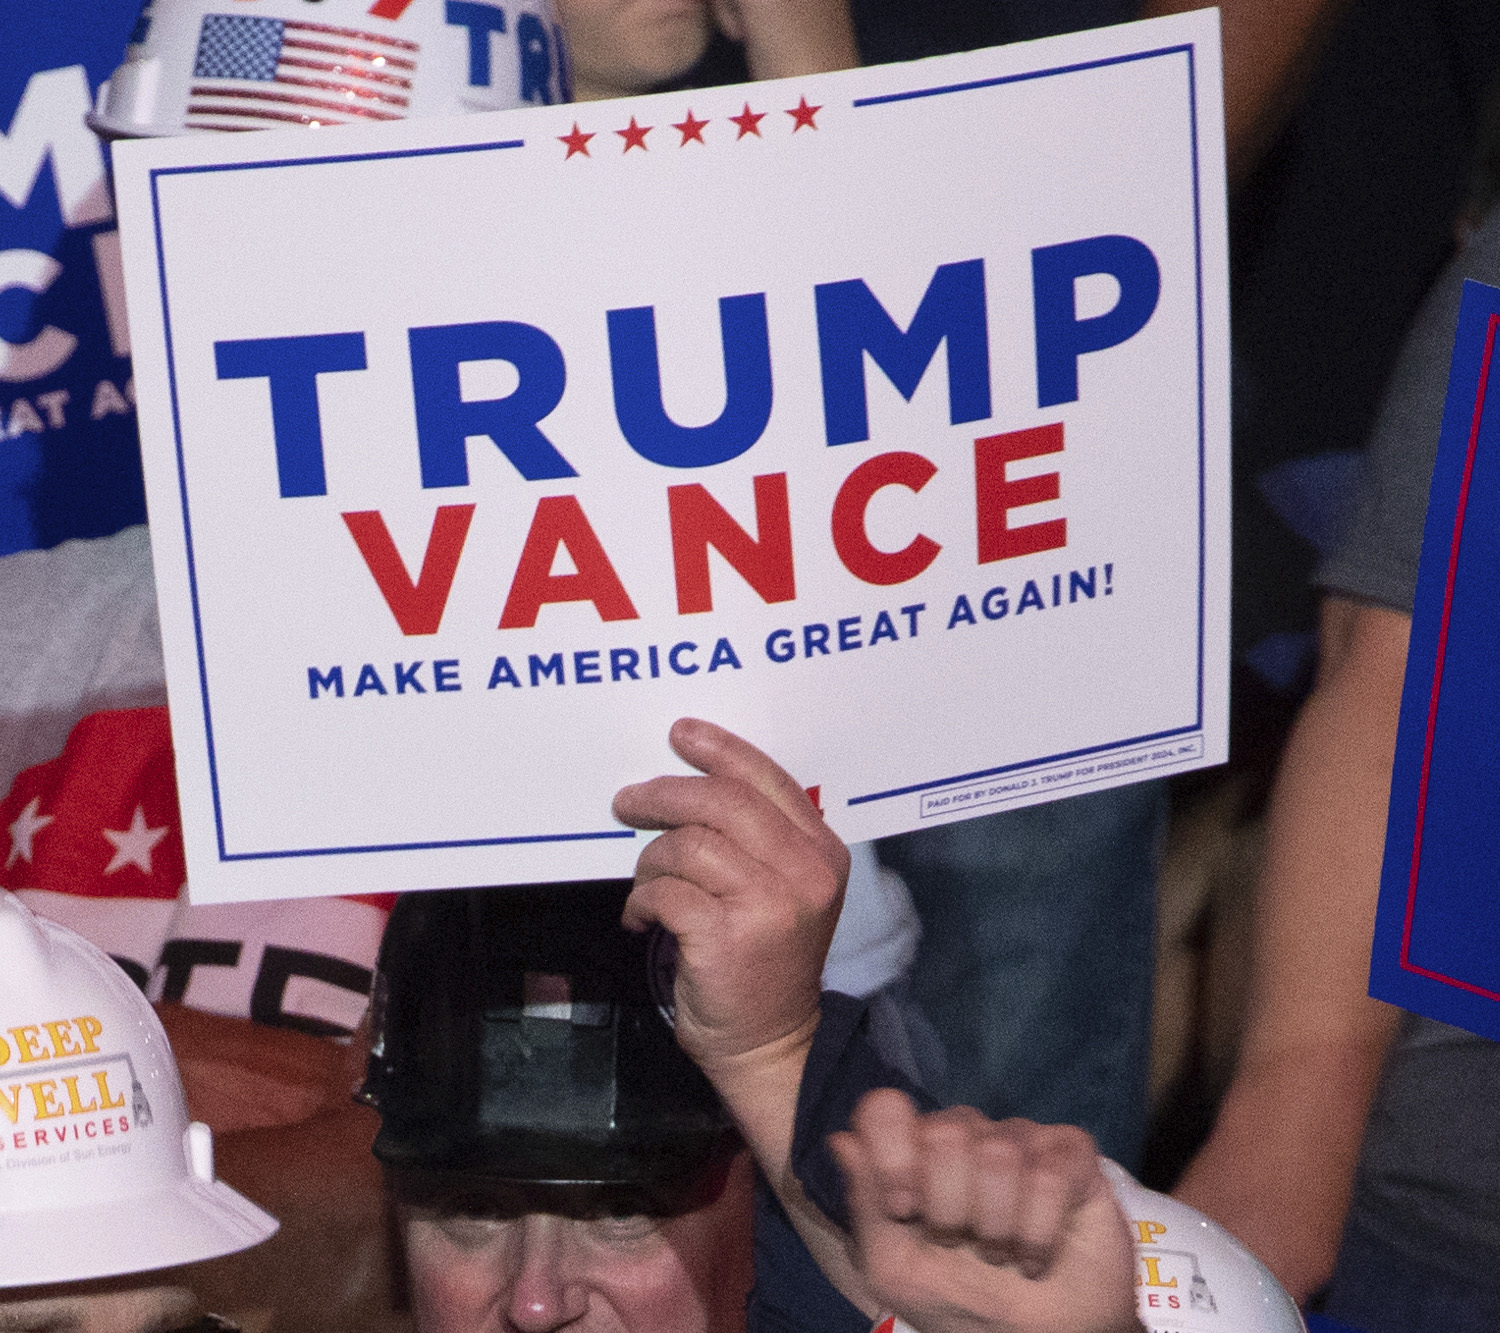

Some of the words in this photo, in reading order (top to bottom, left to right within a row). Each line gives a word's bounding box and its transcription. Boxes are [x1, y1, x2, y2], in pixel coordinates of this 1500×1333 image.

[213, 232, 1162, 499] TRUMP
[340, 421, 1067, 637] VANCE
[306, 659, 464, 701] MAKE
[486, 637, 743, 692] AMERICA
[763, 602, 927, 665] GREAT
[945, 562, 1117, 630] AGAIN!
[927, 797, 950, 809] PAID
[952, 792, 972, 804] FOR
[989, 781, 1029, 797] DONALD
